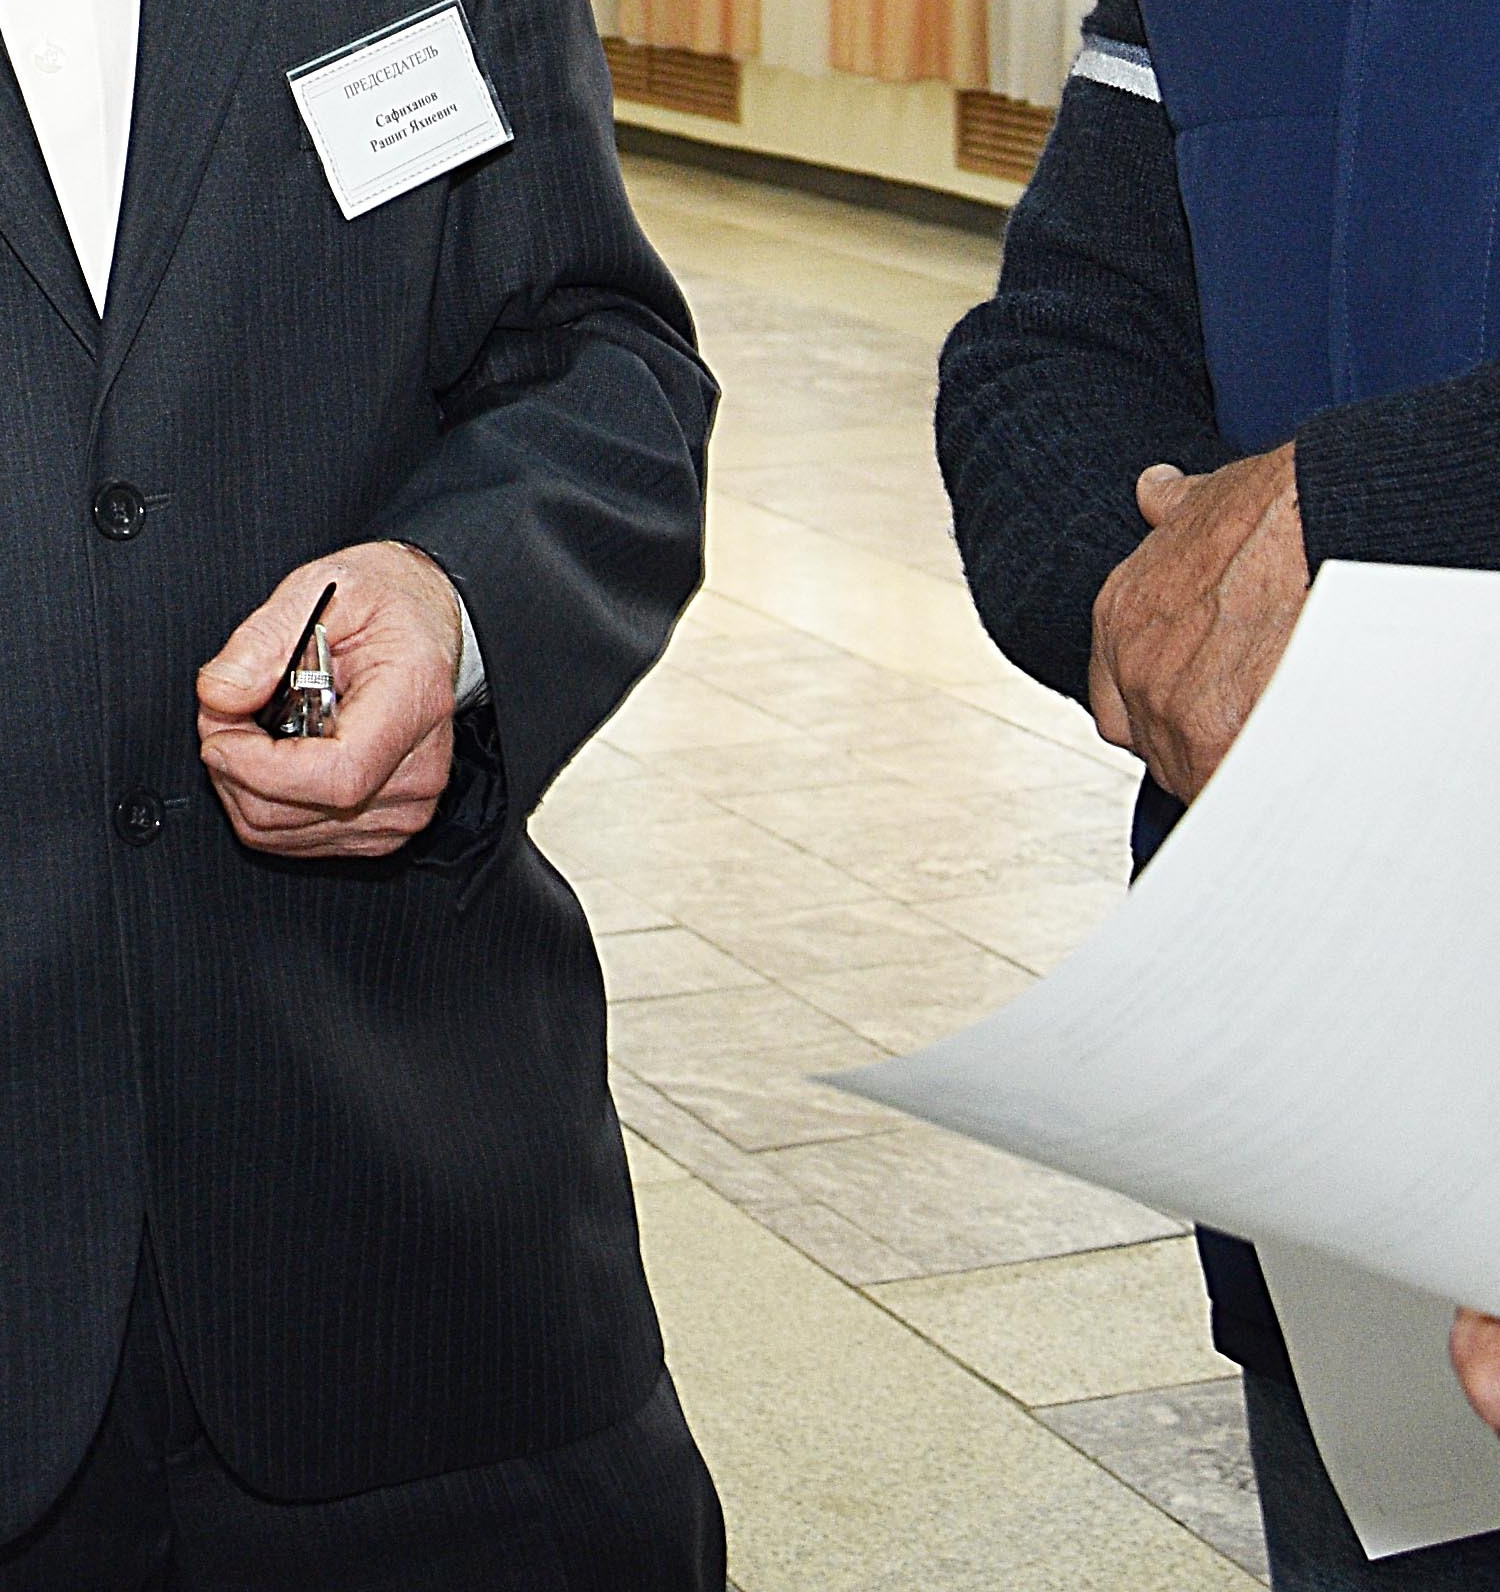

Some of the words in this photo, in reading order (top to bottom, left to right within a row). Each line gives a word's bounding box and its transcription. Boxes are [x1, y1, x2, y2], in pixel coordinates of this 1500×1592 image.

[343, 45, 439, 99] ПРЕДСЕДАТЕЛЬ
[375, 92, 438, 127] Сафиханов
[369, 127, 408, 152] Рашит
